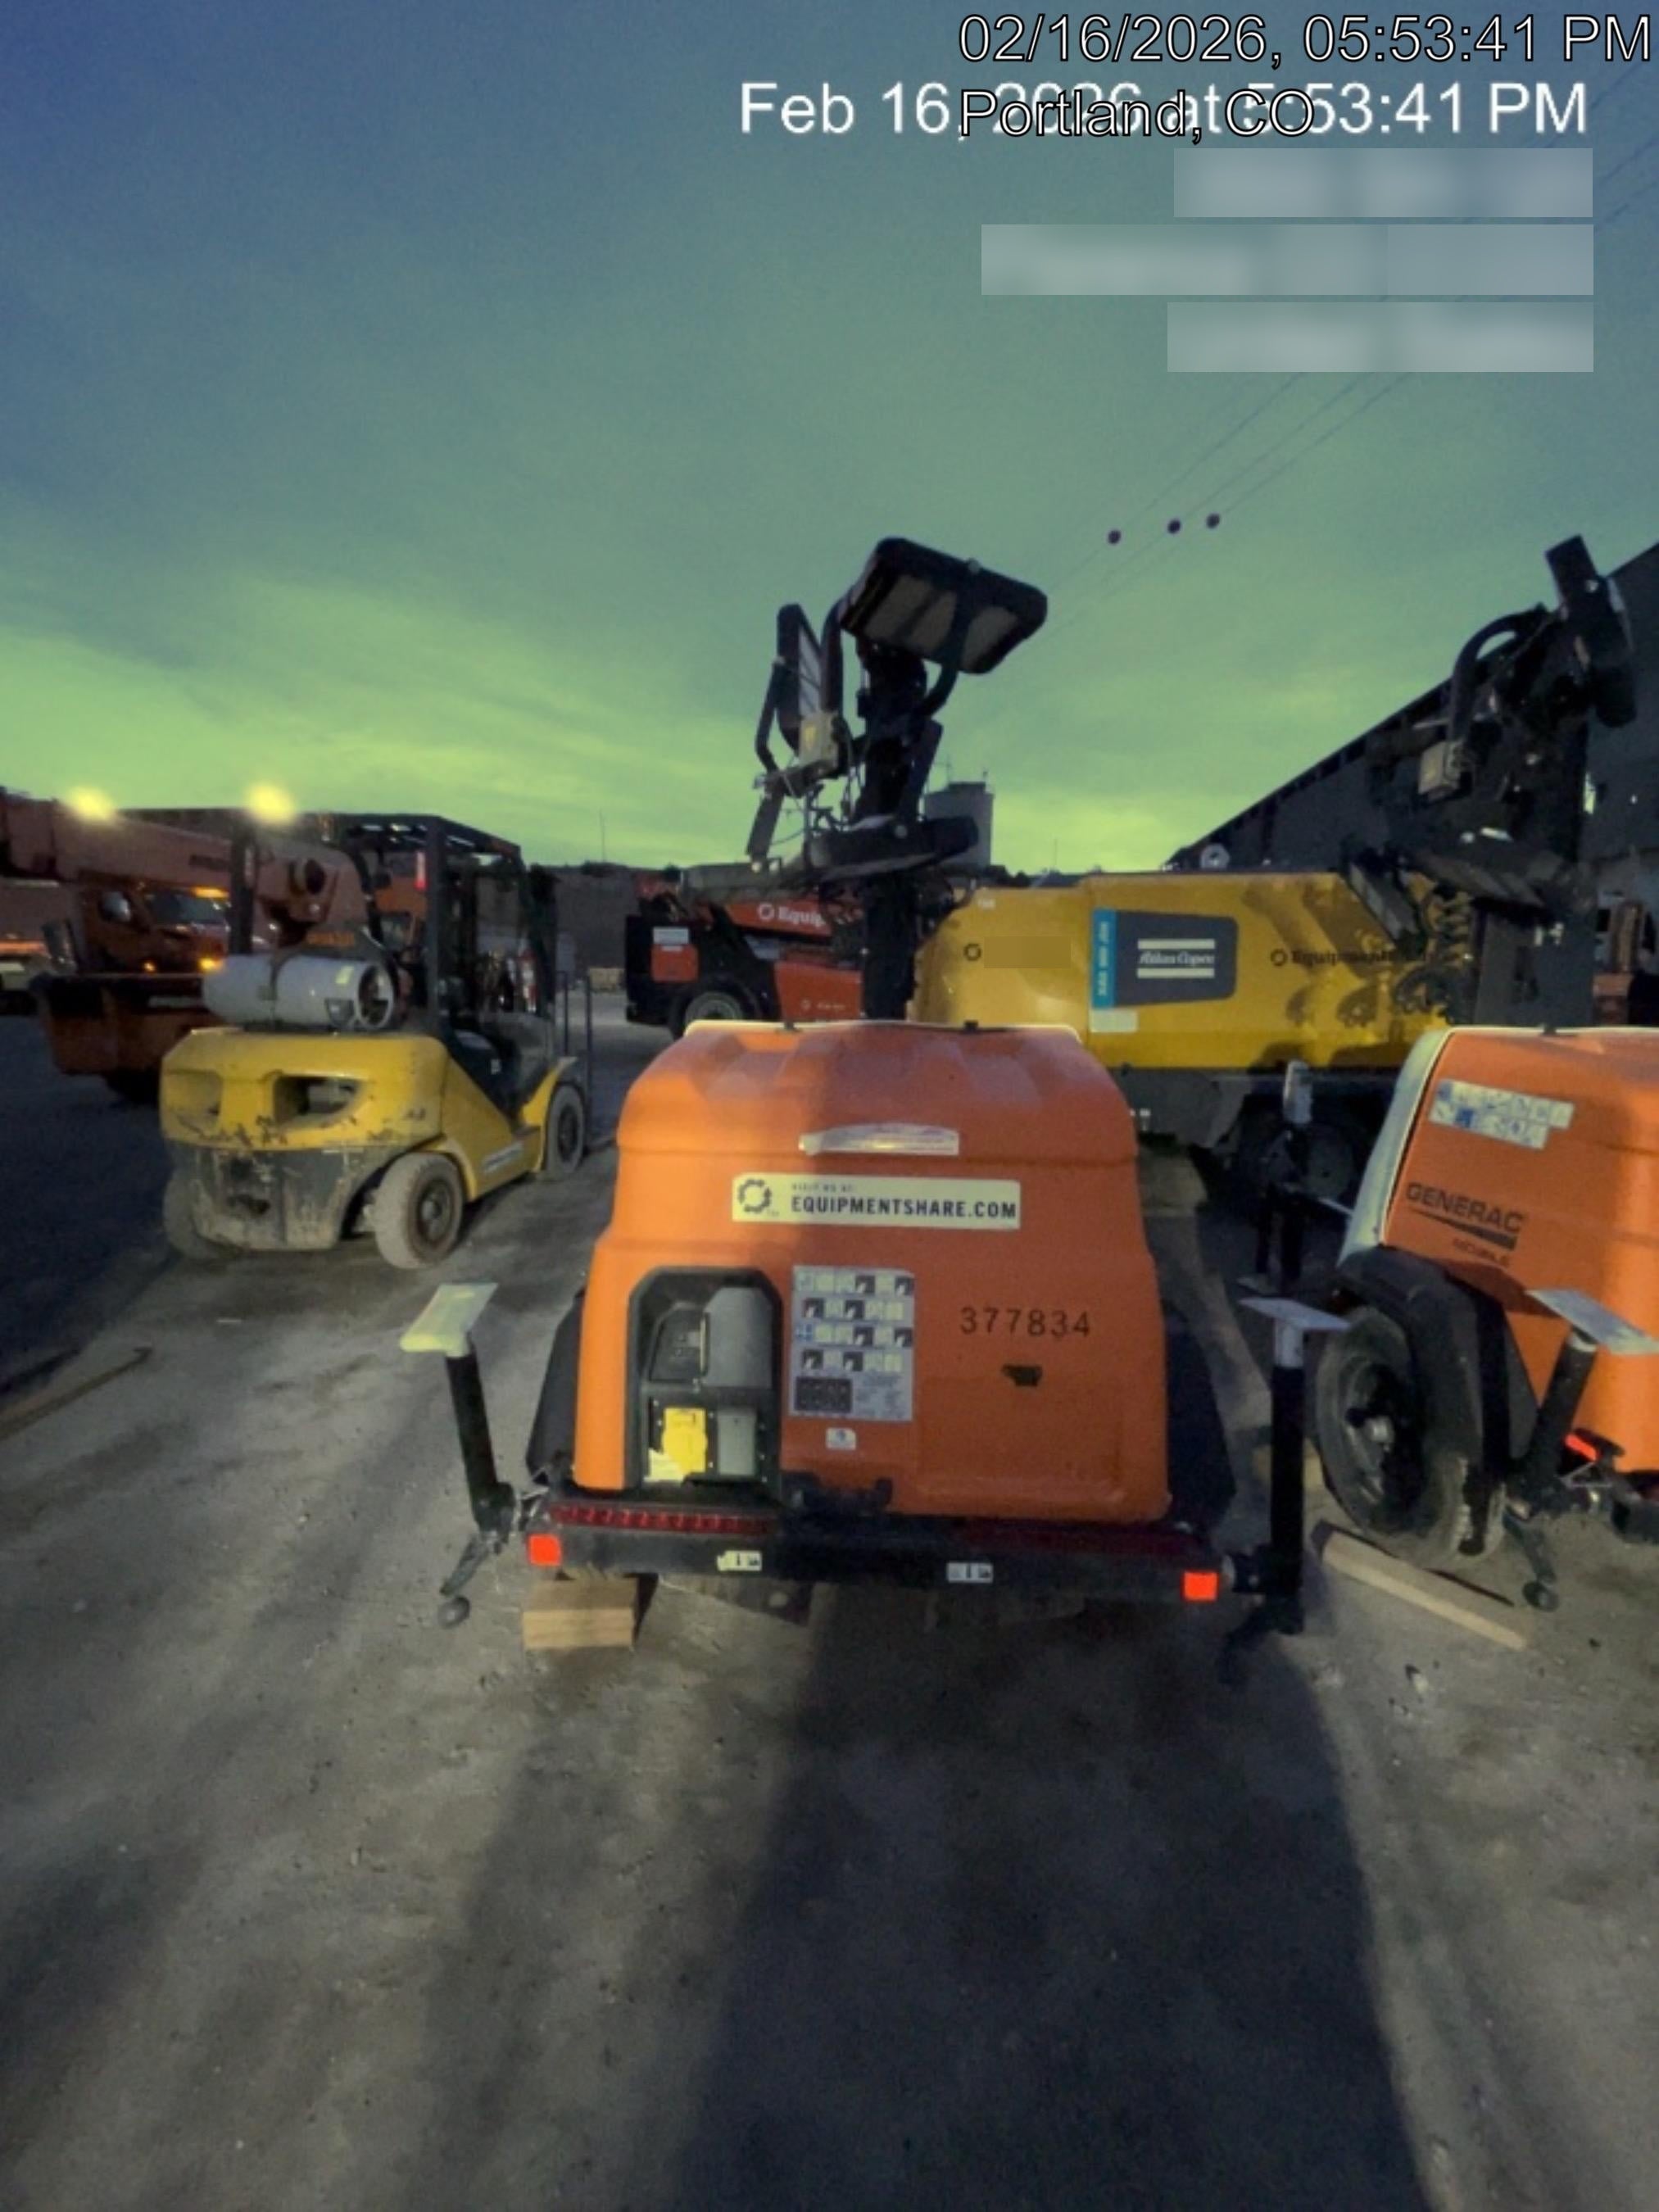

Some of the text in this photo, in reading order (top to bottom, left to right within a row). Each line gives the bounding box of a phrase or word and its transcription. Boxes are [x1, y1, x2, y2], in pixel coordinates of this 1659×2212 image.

[791, 1196, 1017, 1218] EQUIPMENTSHARE.COM
[1406, 1181, 1525, 1233] GENERAC
[960, 1306, 1090, 1339] 377834
